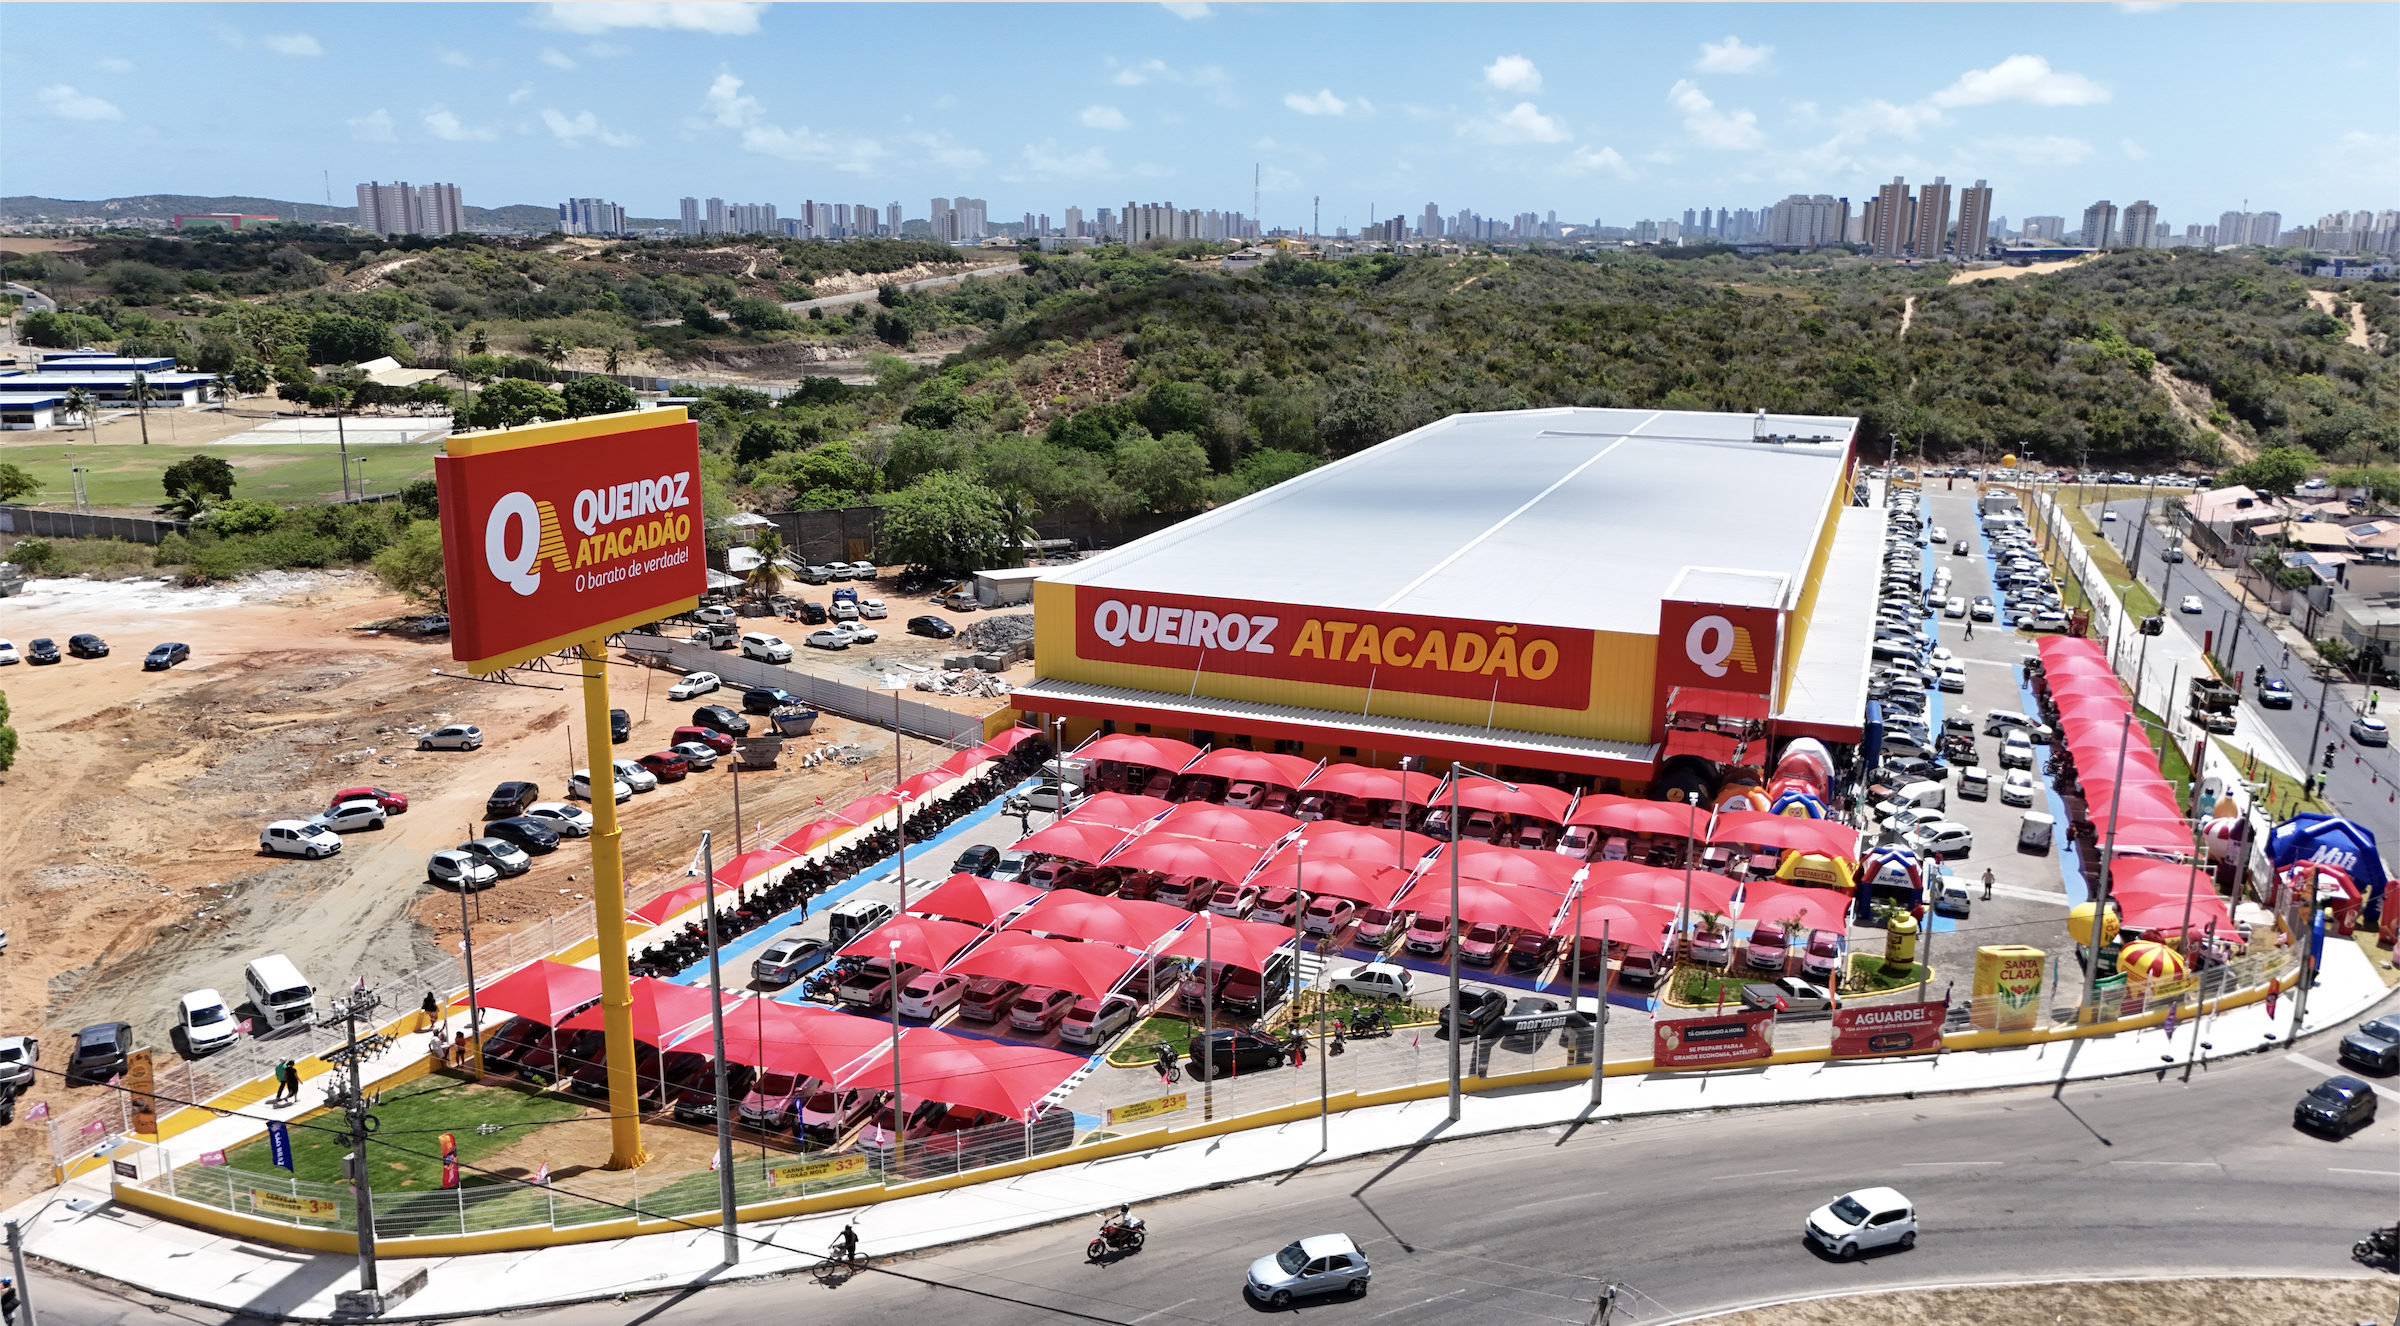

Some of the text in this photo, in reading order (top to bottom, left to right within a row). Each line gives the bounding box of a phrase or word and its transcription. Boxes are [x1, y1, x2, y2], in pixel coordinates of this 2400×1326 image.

[573, 471, 690, 536] QUEIROZ
[574, 511, 691, 569] ATACADÃO
[575, 546, 689, 593] O barato de verdade!
[1093, 599, 1559, 680] QUEIROZ ATACADÃO
[2308, 844, 2358, 871] Mili
[1797, 870, 1833, 880] PRIMAVERA
[1879, 875, 1909, 885] Multigiro
[2005, 959, 2038, 970] SANTA
[1999, 968, 2040, 981] CLARA
[1854, 1008, 1925, 1025] AGUARDE!
[1695, 1029, 1724, 1037] CHEGANDO
[1699, 1052, 1732, 1060] ECONOMIA,
[1121, 1111, 1139, 1119] QUEIJO
[782, 1165, 804, 1175] CARNE
[805, 1162, 830, 1171] BOVINA
[809, 1168, 827, 1176] MOLE
[262, 1198, 302, 1211] BUDWEISER
[266, 1192, 297, 1204] CERVEJA
